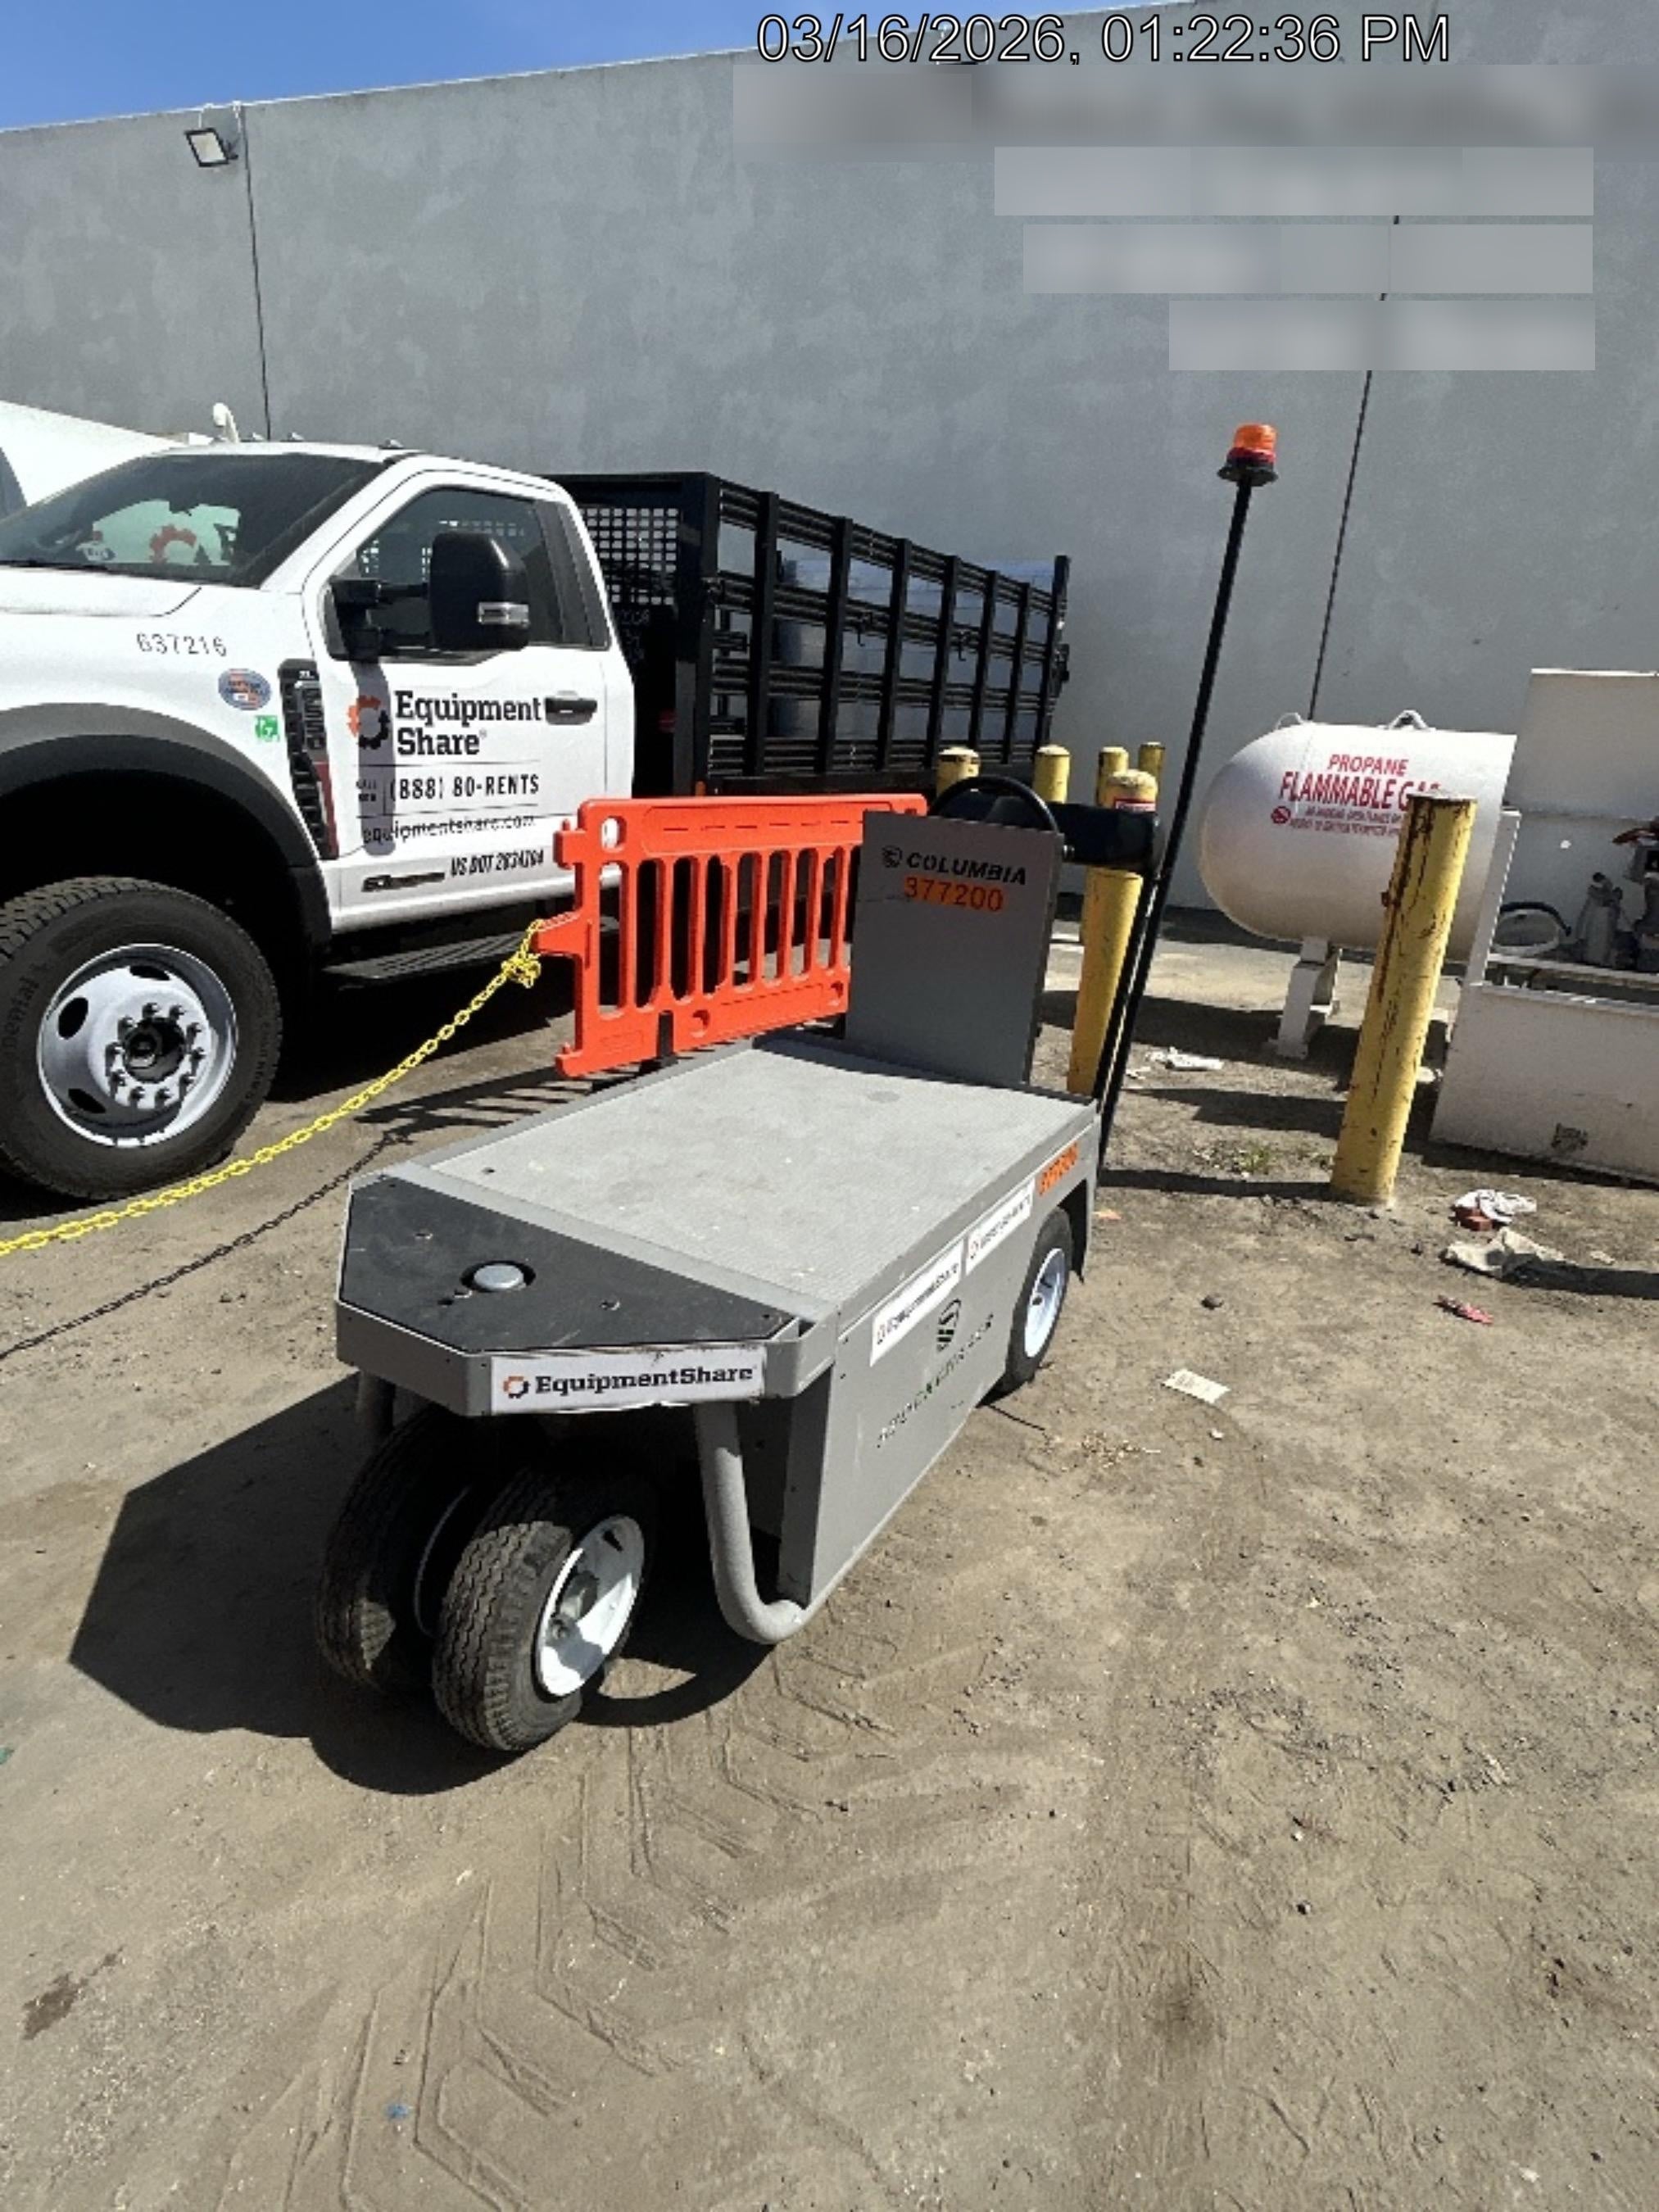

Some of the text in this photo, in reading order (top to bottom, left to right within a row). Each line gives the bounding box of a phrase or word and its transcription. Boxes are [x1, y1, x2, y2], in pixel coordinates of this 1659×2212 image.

[137, 632, 227, 656] 637216
[394, 691, 541, 727] Equipment
[1327, 754, 1409, 777] PROPANE
[390, 774, 539, 802] (888) 80-RENTS
[1278, 771, 1397, 809] FLAMMABLE
[451, 857, 467, 877] US
[469, 854, 494, 874] DOT
[906, 852, 1027, 886] COLUMBIA
[904, 876, 1004, 912] 377200
[535, 1366, 753, 1397] EquipmentShare
